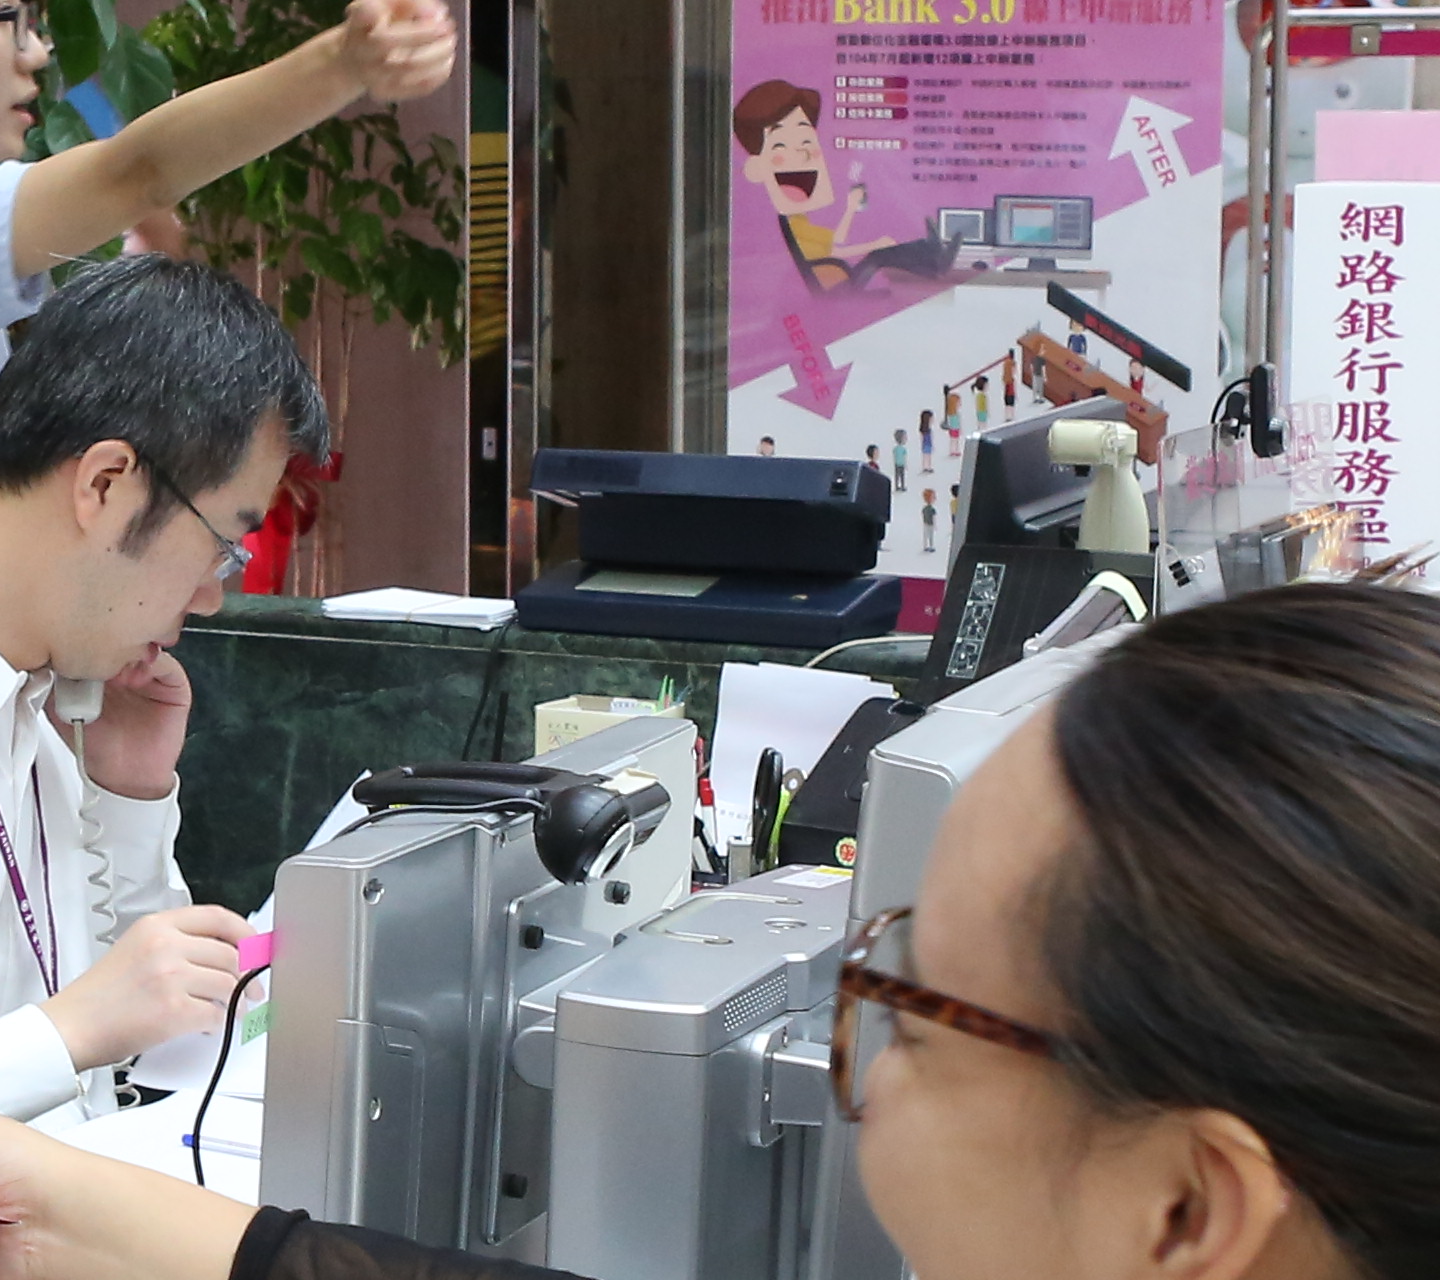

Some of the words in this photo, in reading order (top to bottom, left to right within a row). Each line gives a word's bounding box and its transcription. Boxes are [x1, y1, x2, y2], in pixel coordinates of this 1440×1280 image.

[1131, 115, 1177, 188] AFTER
[1331, 200, 1407, 545] 網路銀行服務區
